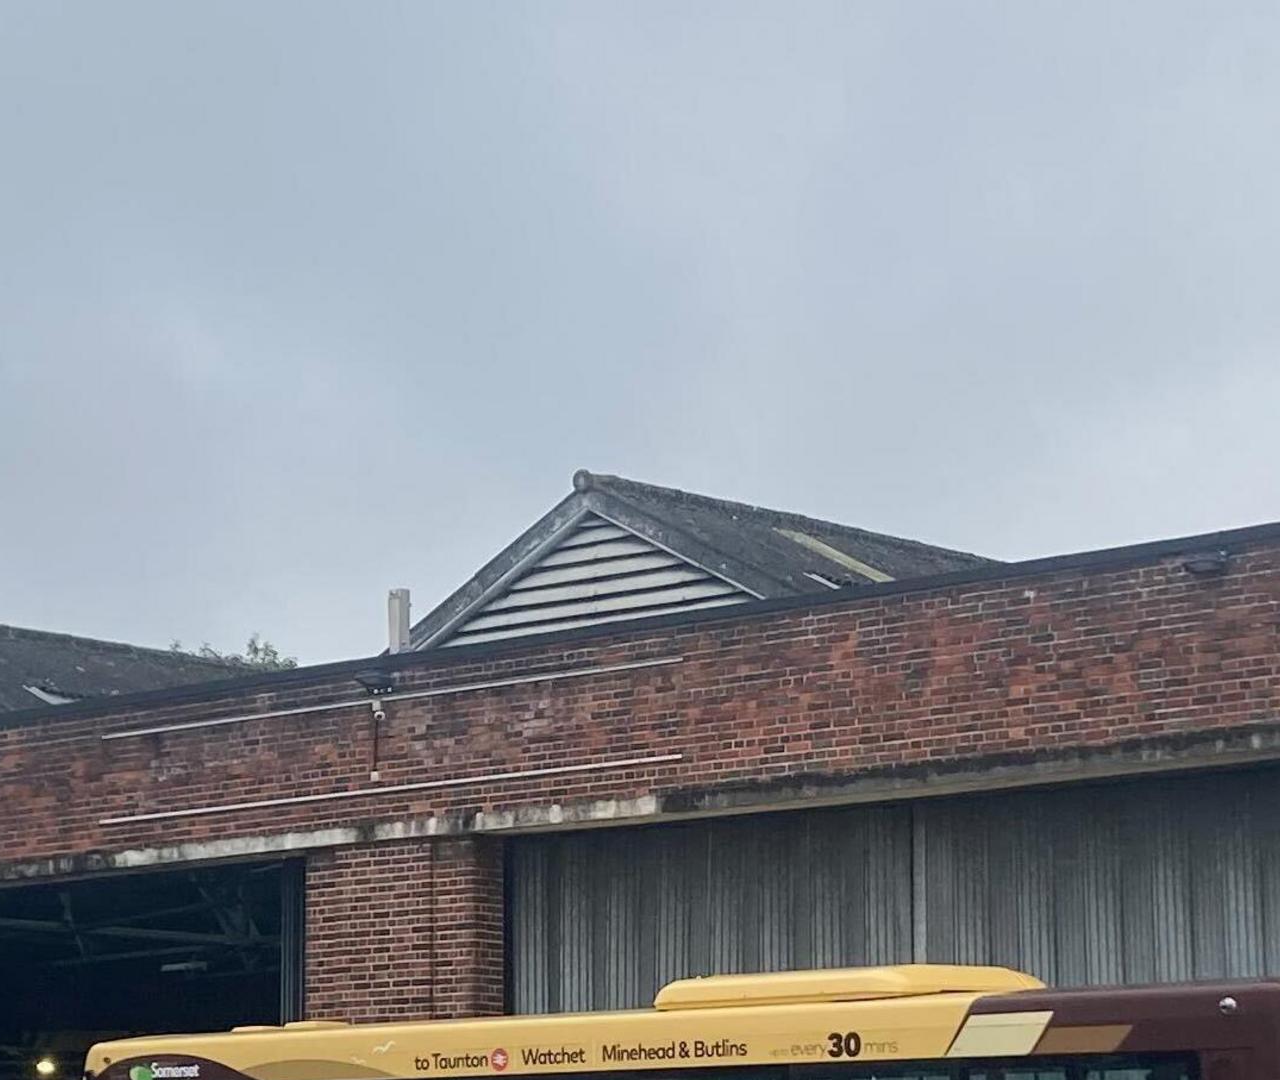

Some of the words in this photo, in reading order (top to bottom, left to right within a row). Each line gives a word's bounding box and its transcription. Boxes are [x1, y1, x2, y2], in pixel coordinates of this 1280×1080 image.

[602, 1040, 675, 1062] Minehead
[678, 1041, 690, 1058] &
[694, 1039, 748, 1057] Butlins
[790, 1043, 827, 1058] every
[827, 1031, 861, 1058] 30
[415, 1056, 430, 1070] to
[432, 1052, 489, 1070] Taunton
[521, 1047, 586, 1065] Watchet
[150, 1062, 200, 1078] Somerset
